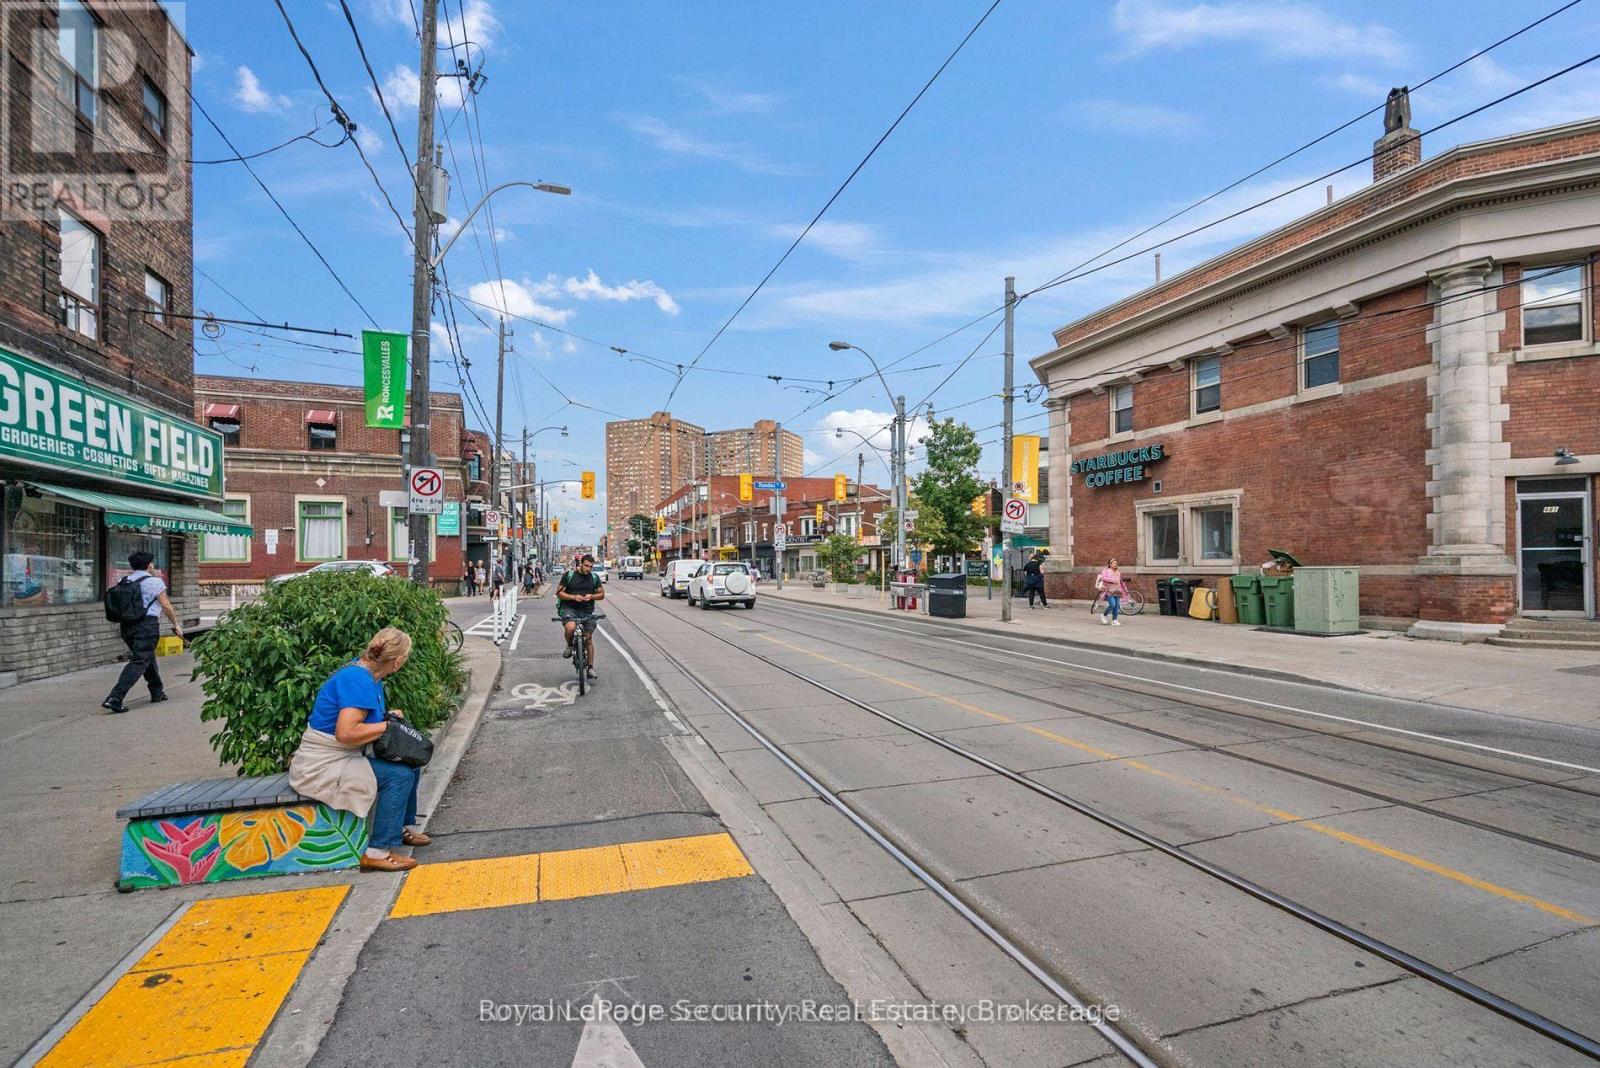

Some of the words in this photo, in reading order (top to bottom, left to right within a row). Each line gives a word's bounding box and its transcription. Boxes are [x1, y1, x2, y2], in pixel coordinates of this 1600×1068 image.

[381, 340, 391, 403] RONCESVALLES
[0, 363, 134, 456] GREEN
[143, 415, 214, 477] FIELD
[1, 428, 75, 458] GROCERIES
[83, 447, 138, 472] COSMETICS
[144, 465, 167, 479] GIFTS
[172, 470, 209, 489] MAGAZINES
[1071, 444, 1162, 474] STARBUCKS
[1085, 465, 1143, 489] COFFEE
[149, 517, 176, 530] FRUIT
[179, 521, 185, 530] &
[187, 523, 229, 533] VEGETABLE
